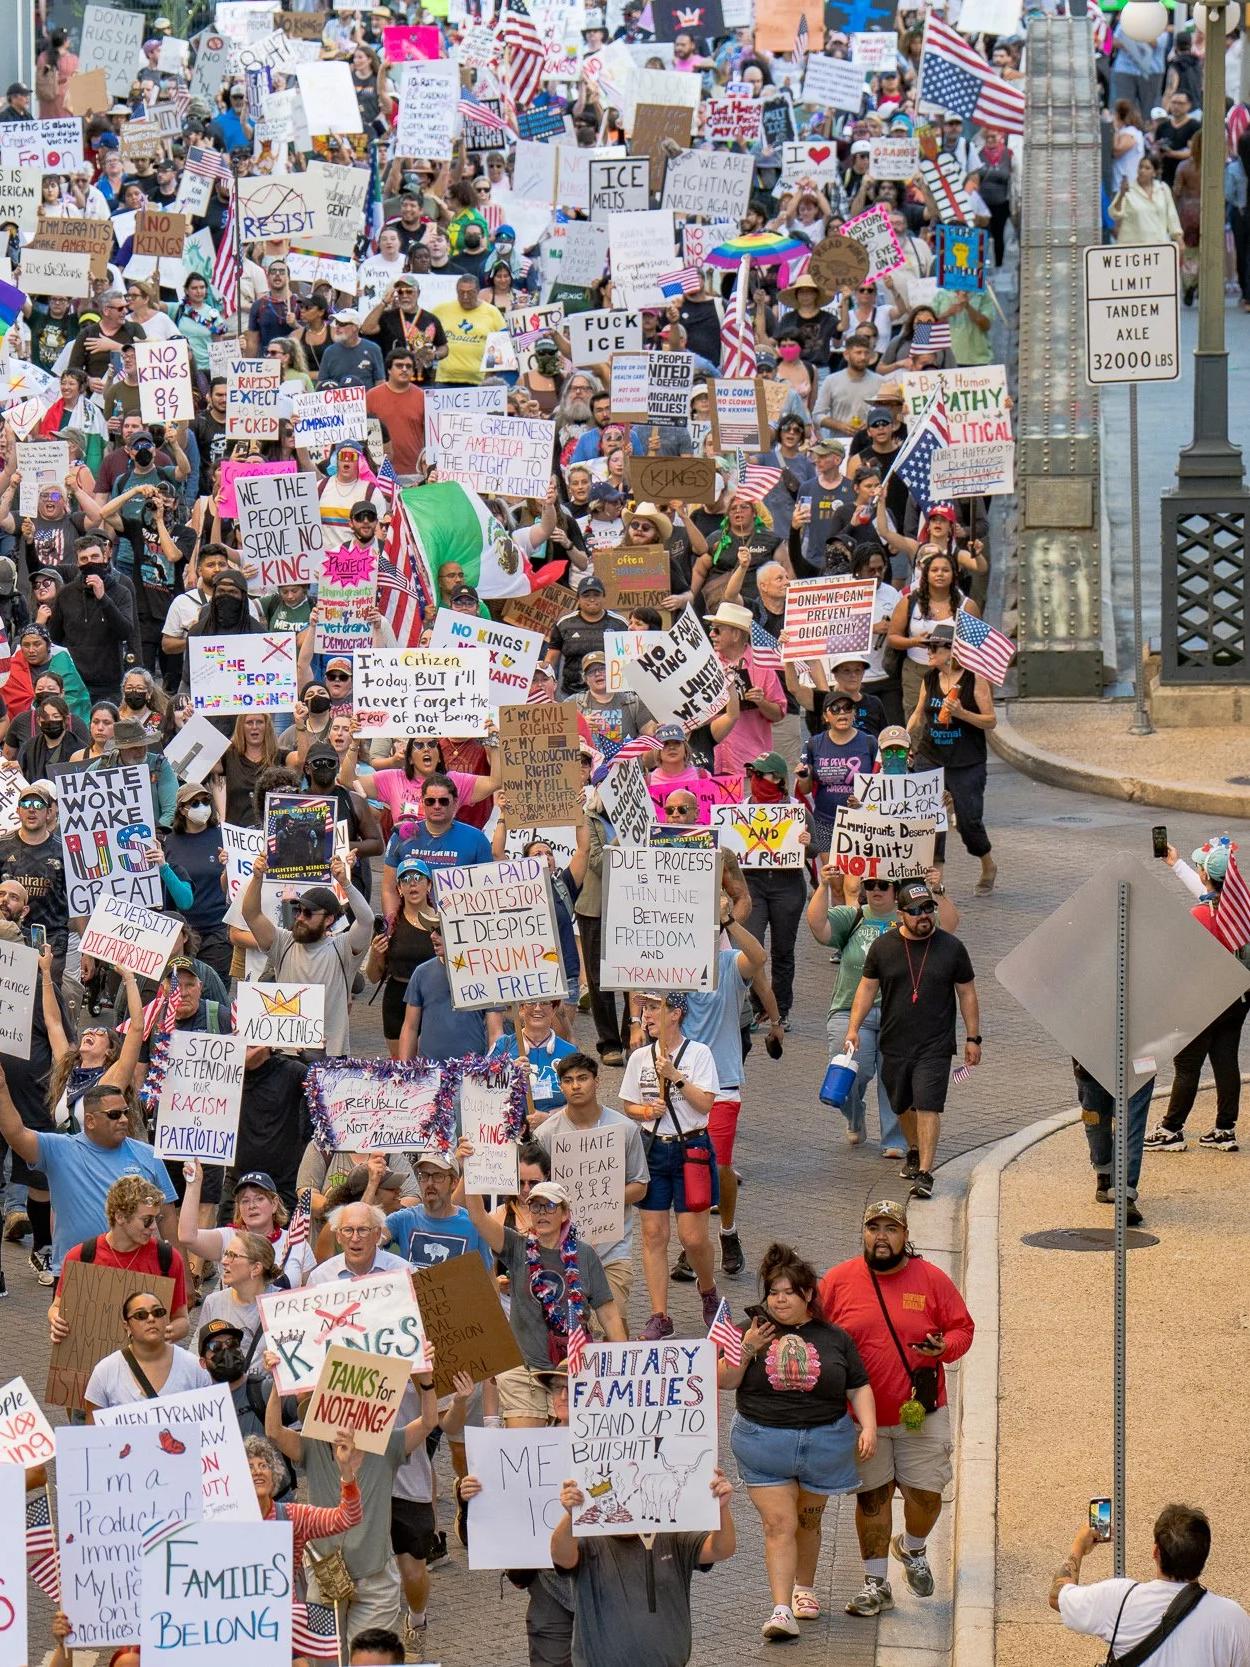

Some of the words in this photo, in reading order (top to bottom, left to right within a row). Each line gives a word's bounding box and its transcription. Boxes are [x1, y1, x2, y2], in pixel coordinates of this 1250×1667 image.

[10, 169, 22, 184] IS
[699, 156, 717, 173] WE
[722, 155, 749, 177] ARE
[671, 173, 743, 198] FIGHTING
[664, 192, 704, 212] NAZIS
[706, 196, 744, 216] AGAIN
[147, 215, 170, 233] NO
[243, 210, 315, 239] RESIST
[136, 236, 182, 256] KINGS
[1102, 252, 1161, 270] WEIGHT
[1111, 276, 1152, 292] LIMIT
[1105, 303, 1160, 319] TANDEM
[585, 314, 638, 331] FUCK
[1116, 327, 1150, 341] AXLE
[149, 346, 177, 363] NO
[588, 337, 626, 353] ICE
[1093, 351, 1152, 371] 32000
[1154, 353, 1174, 368] LBS
[138, 362, 188, 383] KINGS
[154, 387, 178, 406] 86
[717, 389, 729, 397] NO
[732, 389, 755, 398] CONS
[717, 399, 727, 407] NO
[156, 404, 179, 420] 47
[236, 481, 262, 507] WE
[273, 476, 308, 501] THE
[246, 505, 311, 529] PEOPLE
[243, 530, 292, 558] SERVE
[299, 524, 323, 553] NO
[260, 553, 310, 585] KING
[797, 593, 822, 607] ONLY
[824, 593, 840, 604] WE
[842, 589, 864, 603] CAN
[806, 607, 851, 622] PREVENT
[797, 622, 857, 640] OLIGARCHY
[269, 808, 289, 816] TRUE
[291, 805, 331, 814] PATRIOTS
[837, 809, 895, 839] Immigrants
[899, 823, 934, 842] Deserve
[836, 832, 912, 858] Dignity
[611, 850, 647, 873] DUE
[655, 850, 713, 873] PROCESS
[836, 855, 881, 881] NOT
[638, 874, 648, 884] IS
[657, 874, 680, 885] THE
[620, 886, 656, 902] THIN
[664, 889, 698, 904] LINE
[105, 898, 177, 939] DIVERSITY
[634, 907, 694, 924] BETWEEN
[112, 922, 145, 942] NOT
[615, 927, 695, 948] FREEDOM
[82, 930, 164, 976] DICTATORSHIP
[641, 950, 664, 961] AND
[244, 1018, 272, 1041] NO
[278, 1019, 324, 1045] KINGS
[186, 1038, 235, 1062] STOP
[167, 1058, 242, 1085] PRETENDING
[193, 1081, 210, 1094] YOUR
[171, 1093, 227, 1115] RACISM
[194, 1115, 202, 1127] IS
[160, 1125, 236, 1156] PATRIOTISM
[579, 1345, 701, 1377] MILITARY
[327, 1361, 379, 1401] TANKS
[376, 1376, 395, 1402] for
[573, 1375, 704, 1407] FAMILIES
[313, 1392, 395, 1435] NOTHING!
[574, 1412, 635, 1440] STAND
[641, 1410, 671, 1434] UP
[678, 1407, 705, 1433] TO
[166, 1540, 290, 1600] FAMILIES
[151, 1607, 279, 1649] BELONG
